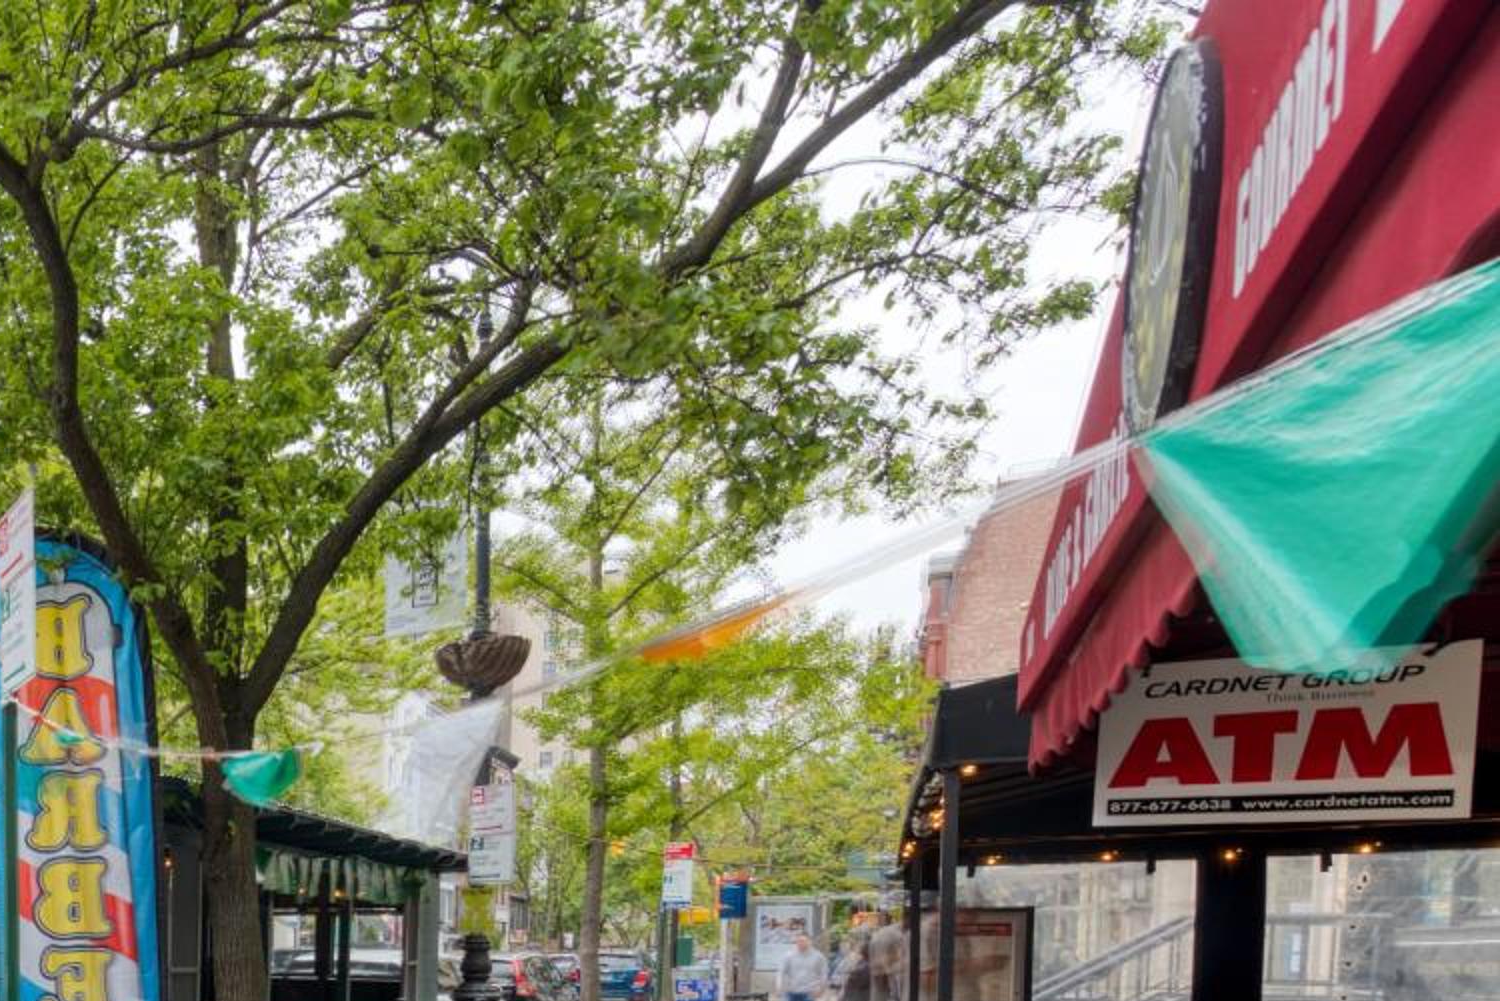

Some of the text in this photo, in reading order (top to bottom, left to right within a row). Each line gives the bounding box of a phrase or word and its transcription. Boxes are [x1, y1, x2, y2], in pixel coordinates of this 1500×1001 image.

[1145, 664, 1426, 699] CARDNET GROUP
[1107, 702, 1454, 788] ATM
[1242, 793, 1452, 811] www.cardnetatm.com
